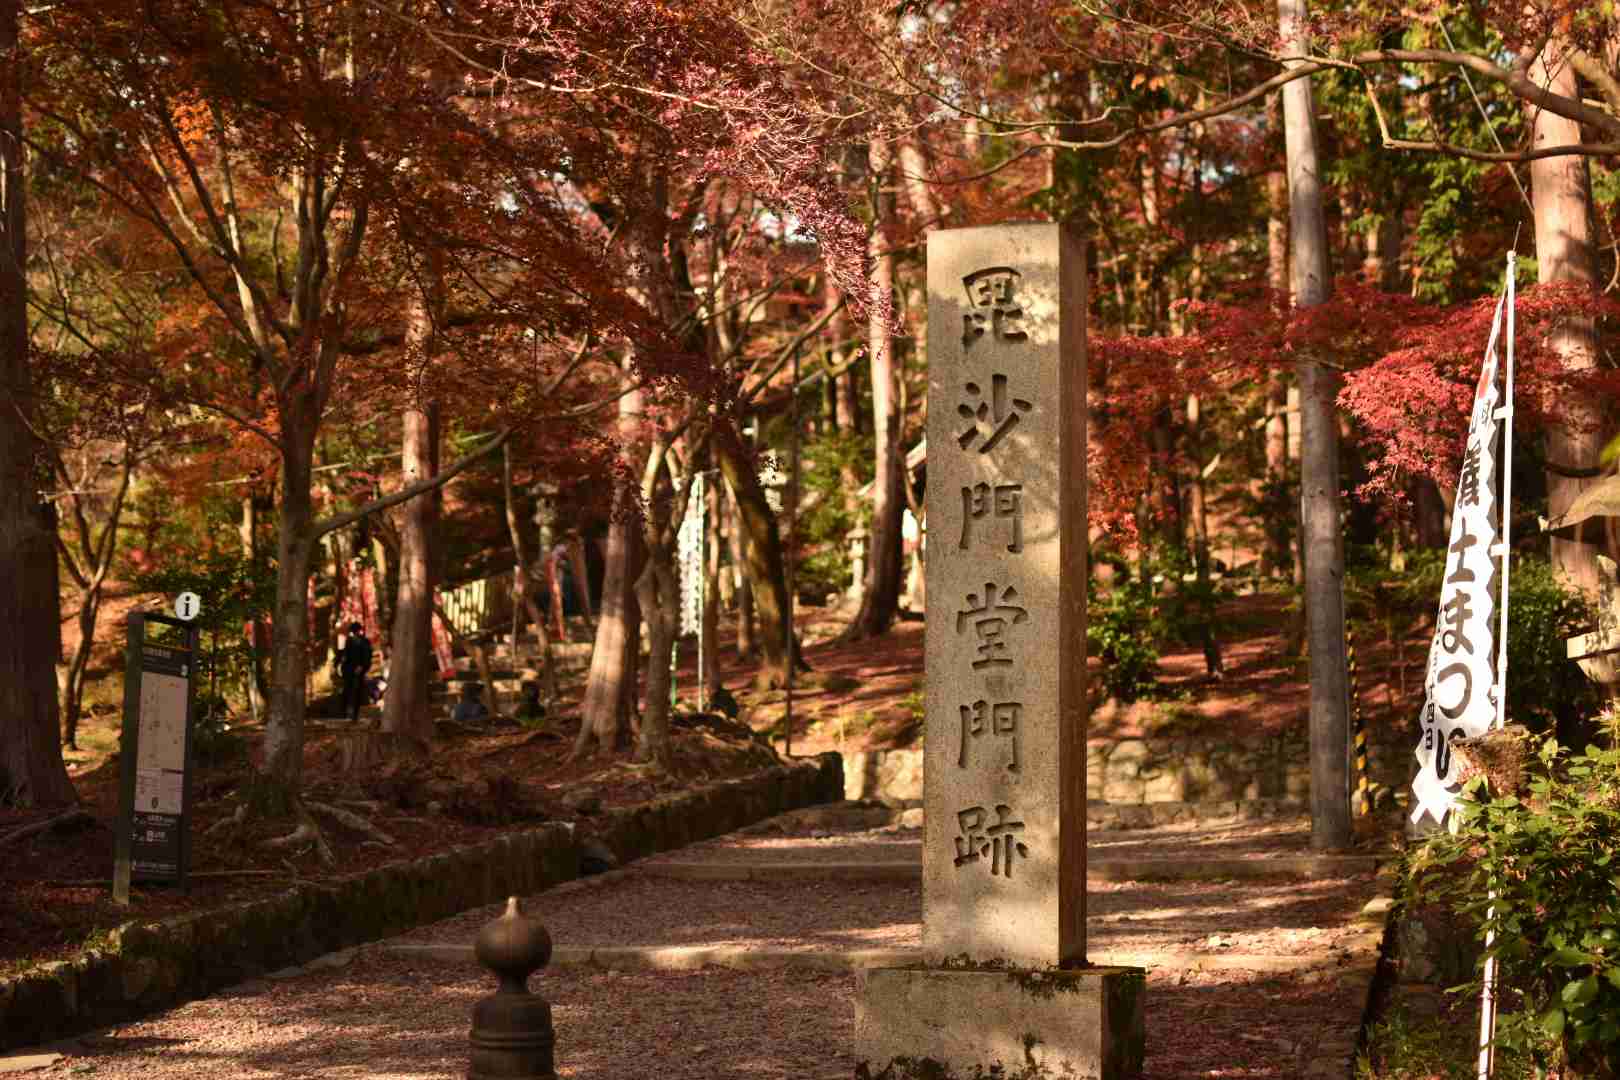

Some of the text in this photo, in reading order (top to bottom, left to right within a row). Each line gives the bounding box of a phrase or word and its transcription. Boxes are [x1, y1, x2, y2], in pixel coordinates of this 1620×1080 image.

[954, 266, 1032, 879] 毘沙門堂門跡
